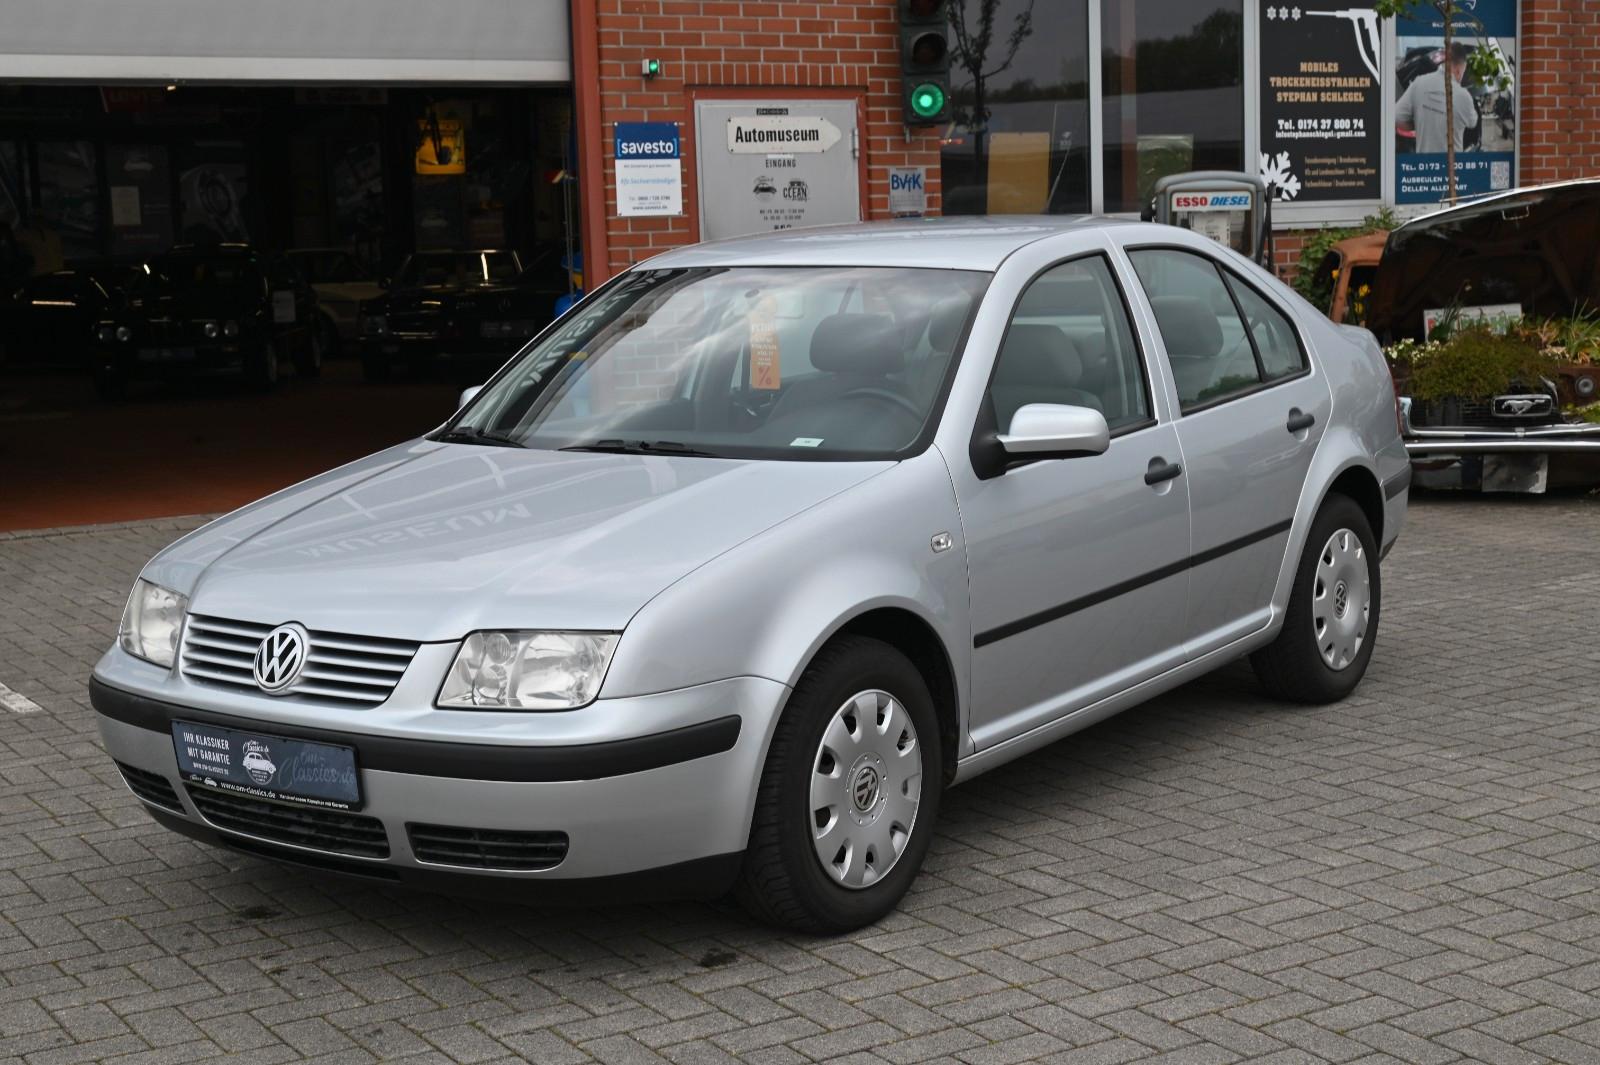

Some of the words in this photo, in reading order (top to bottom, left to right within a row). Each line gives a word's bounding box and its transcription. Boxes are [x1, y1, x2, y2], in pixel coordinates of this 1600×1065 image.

[1300, 62, 1338, 72] MOBILES
[1270, 77, 1370, 87] TROCKENEISSTRAHLEN
[1277, 92, 1317, 102] STEPHAN
[1321, 92, 1364, 102] SCHLEGEL
[1278, 119, 1295, 130] Tel.
[1298, 119, 1318, 129] 0174
[1321, 119, 1332, 129] 37
[1334, 119, 1351, 129] 800
[1353, 119, 1364, 129] 74
[735, 126, 819, 143] Automuseum
[765, 159, 796, 168] EINGANG
[1176, 197, 1208, 207] ESSO
[1210, 196, 1249, 206] DIESEL
[253, 628, 303, 688] VW
[183, 732, 195, 744] IHR
[195, 734, 230, 751] KLASSIKER
[187, 747, 199, 759] MIT
[199, 750, 231, 765] GARANTIE
